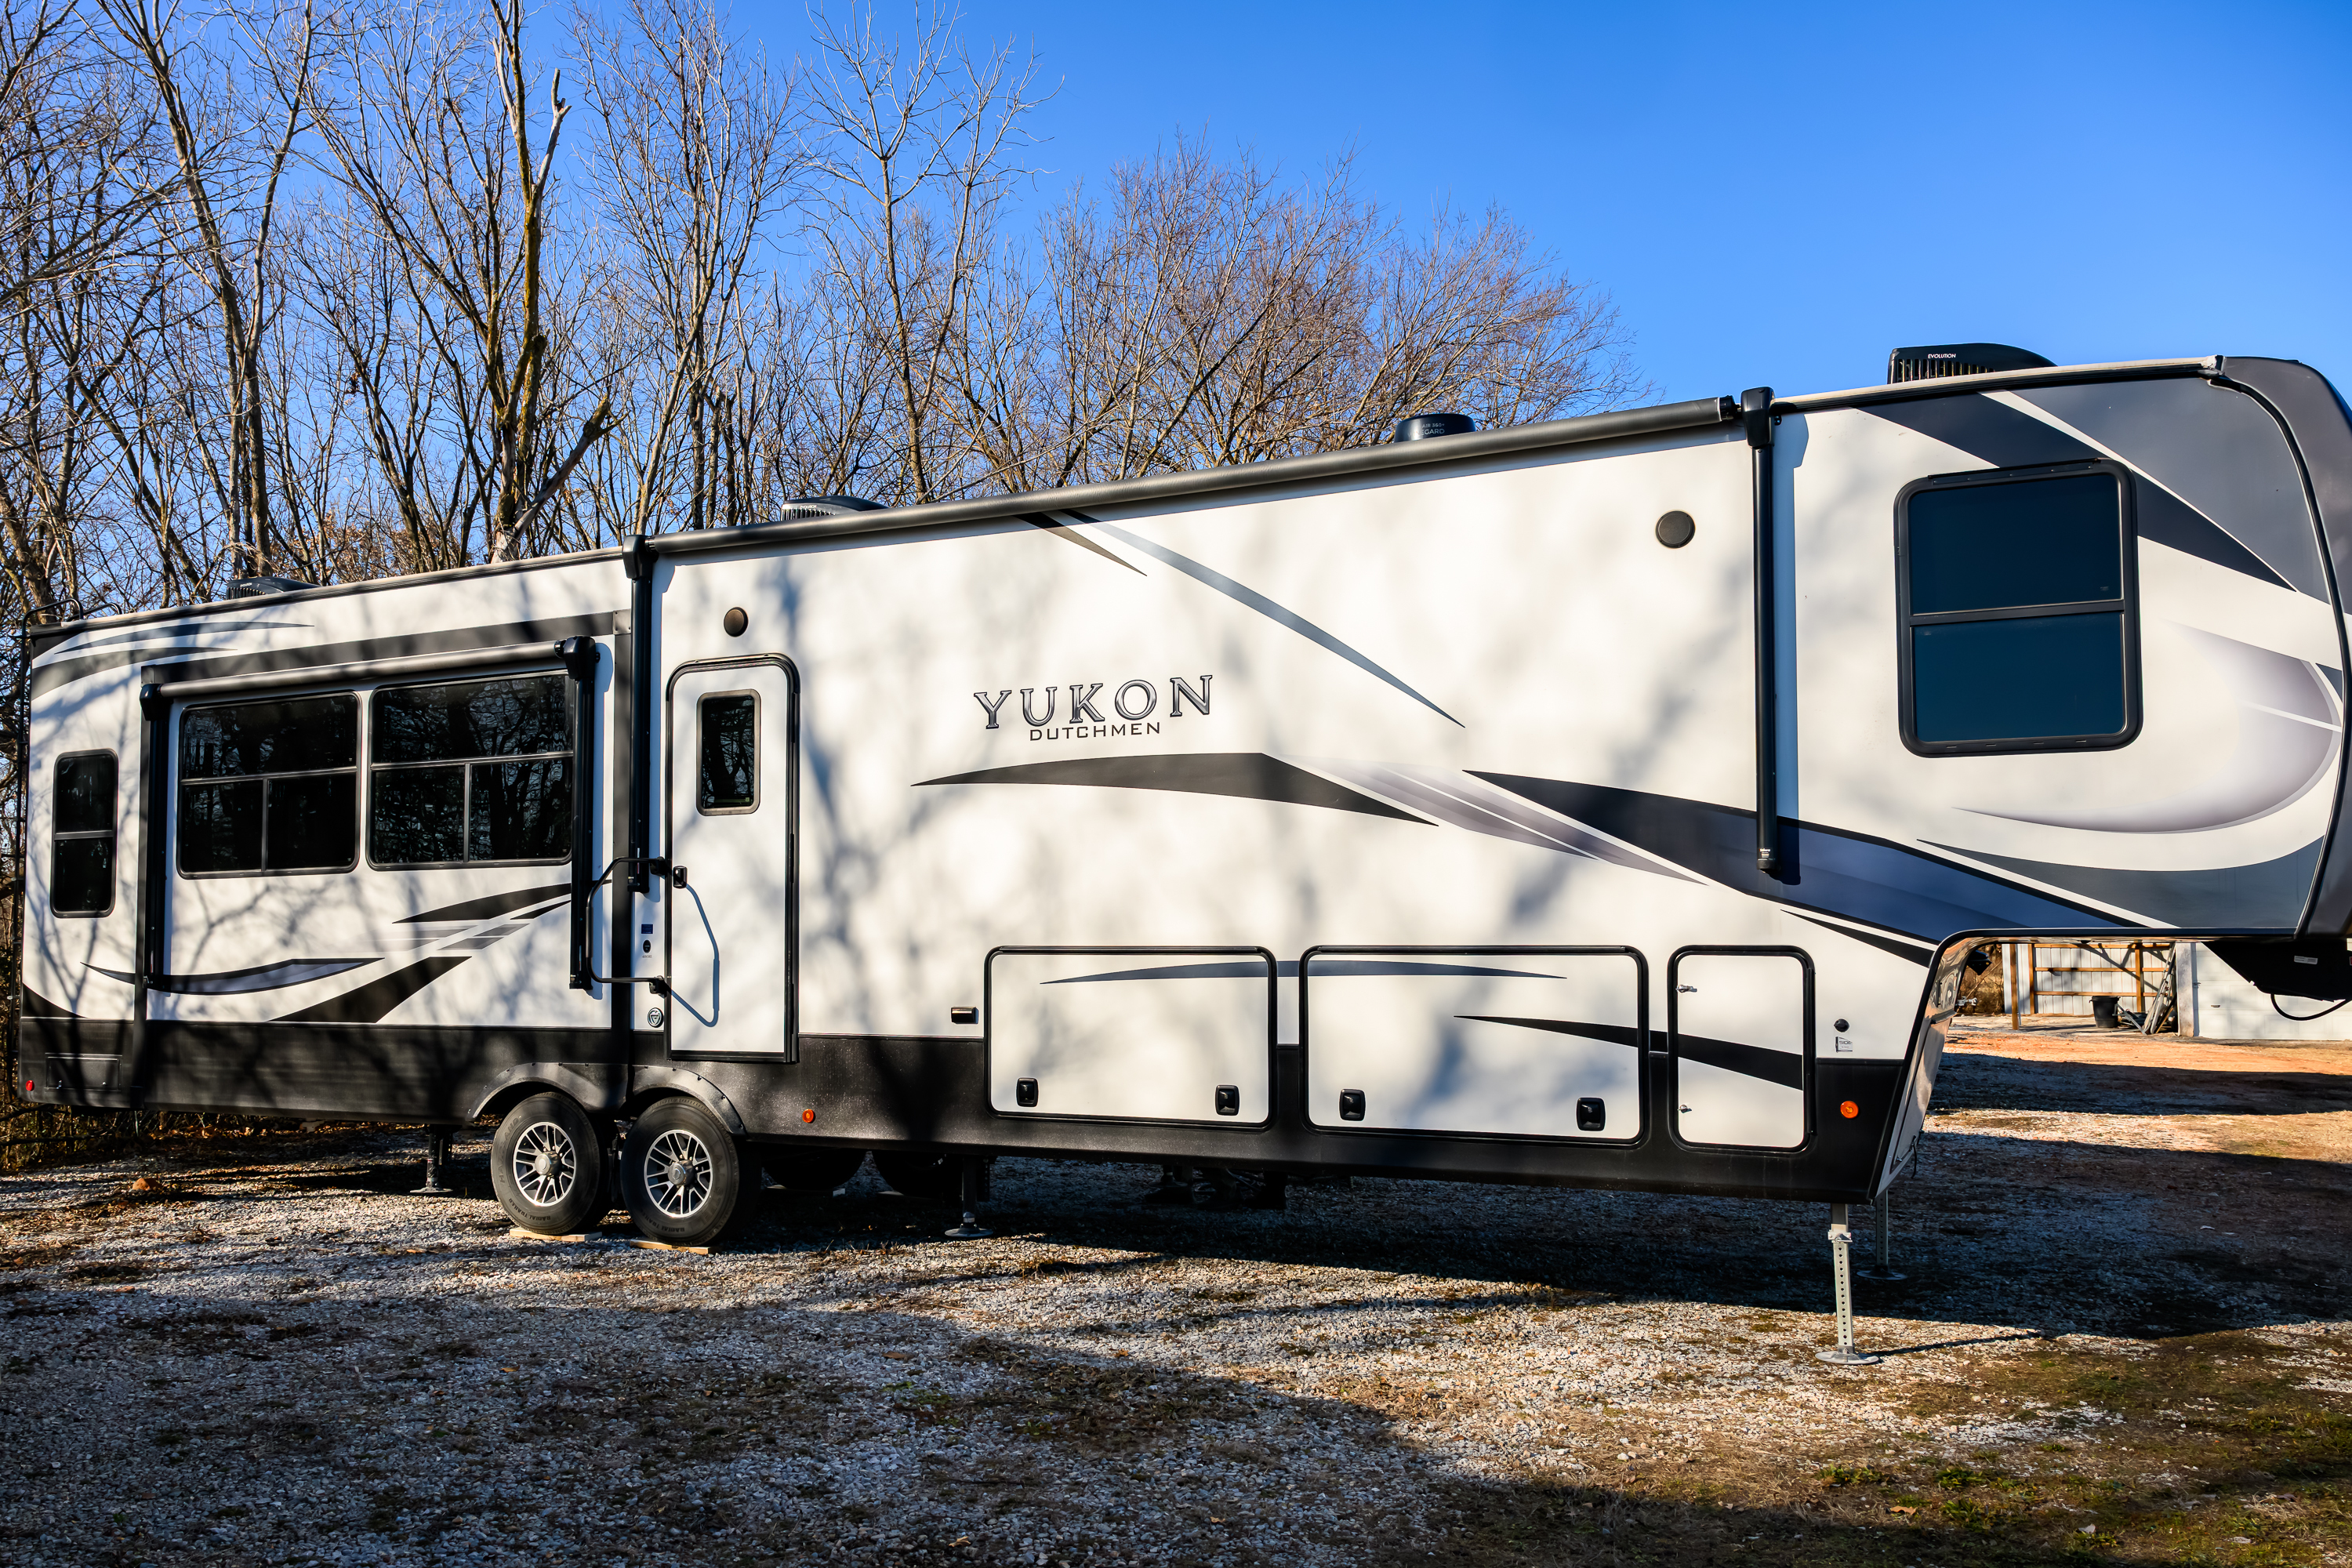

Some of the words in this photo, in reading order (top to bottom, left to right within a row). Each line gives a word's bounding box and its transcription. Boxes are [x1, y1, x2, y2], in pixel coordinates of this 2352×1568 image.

[974, 675, 1213, 729] YUKON
[1029, 721, 1160, 741] DUTCHMEN
[508, 1197, 528, 1218] TRAILER
